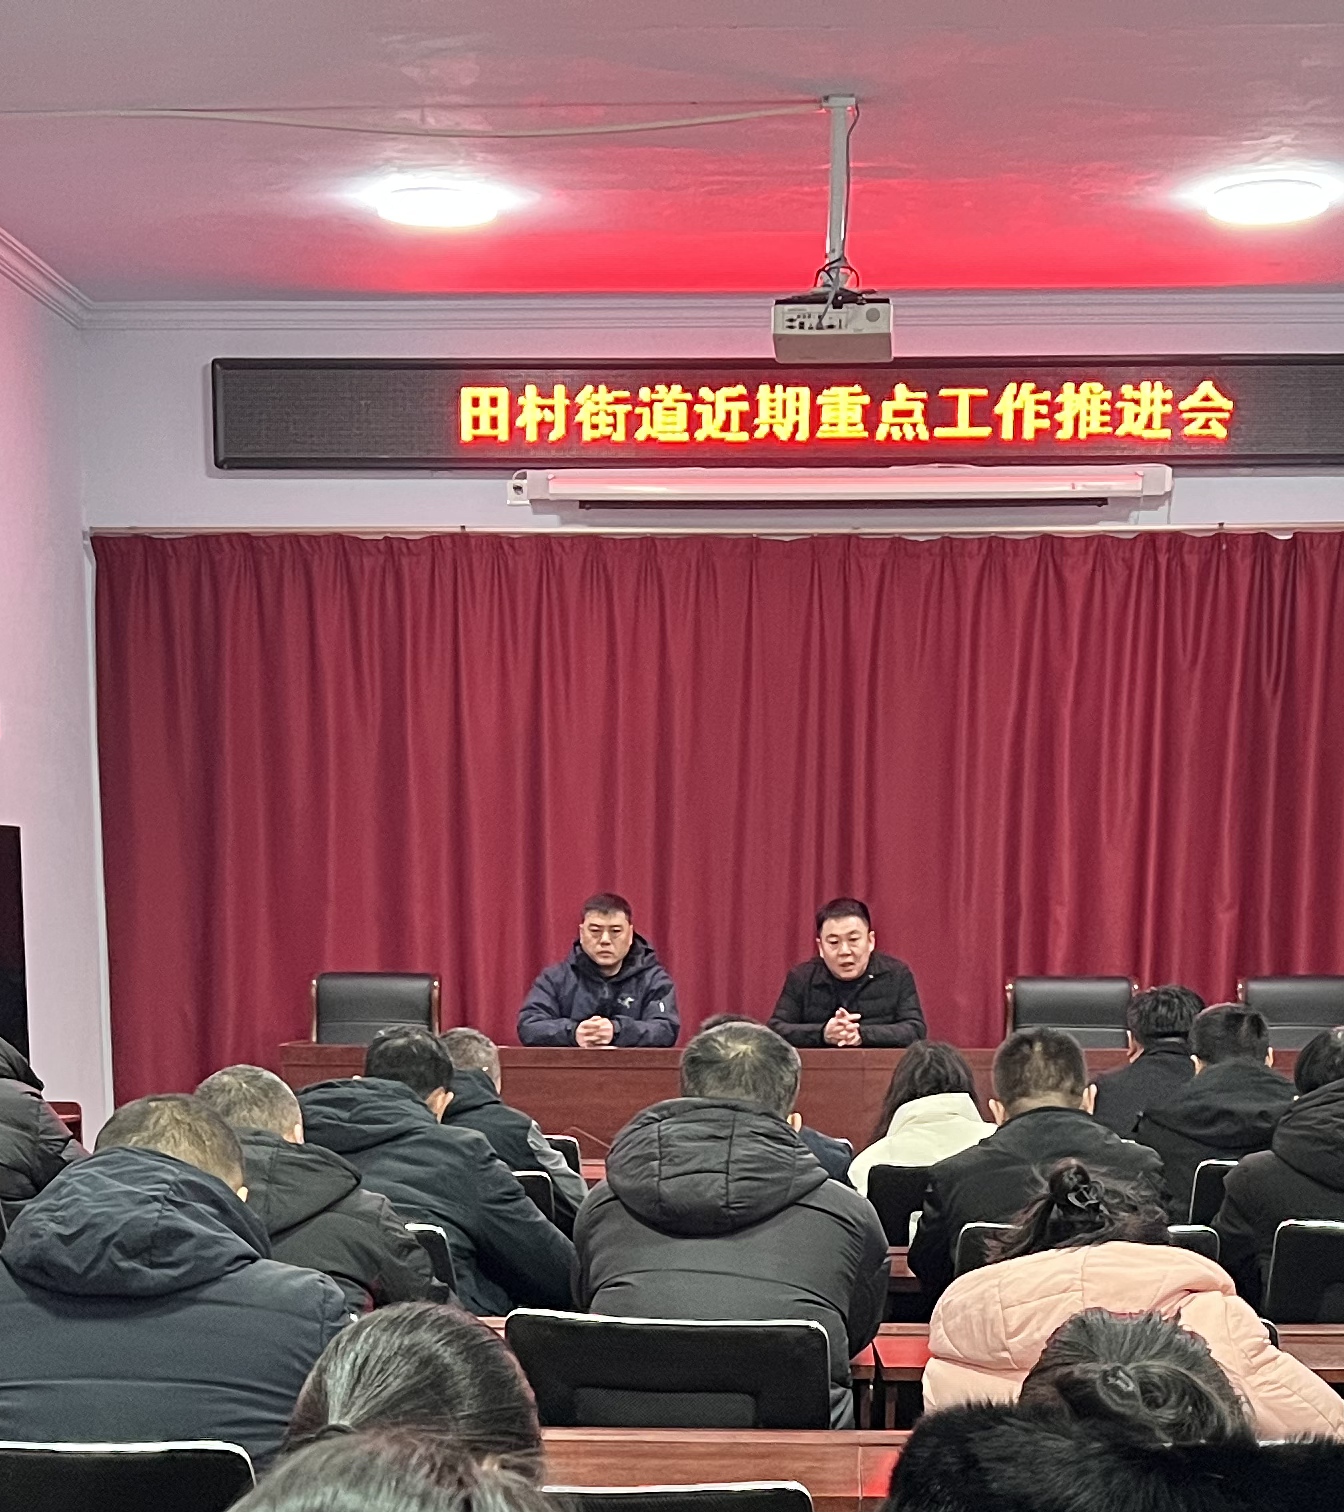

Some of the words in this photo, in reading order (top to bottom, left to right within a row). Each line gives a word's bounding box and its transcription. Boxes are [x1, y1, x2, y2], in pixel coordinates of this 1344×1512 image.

[458, 380, 1234, 443] 田村街道近期重点工作推进会
